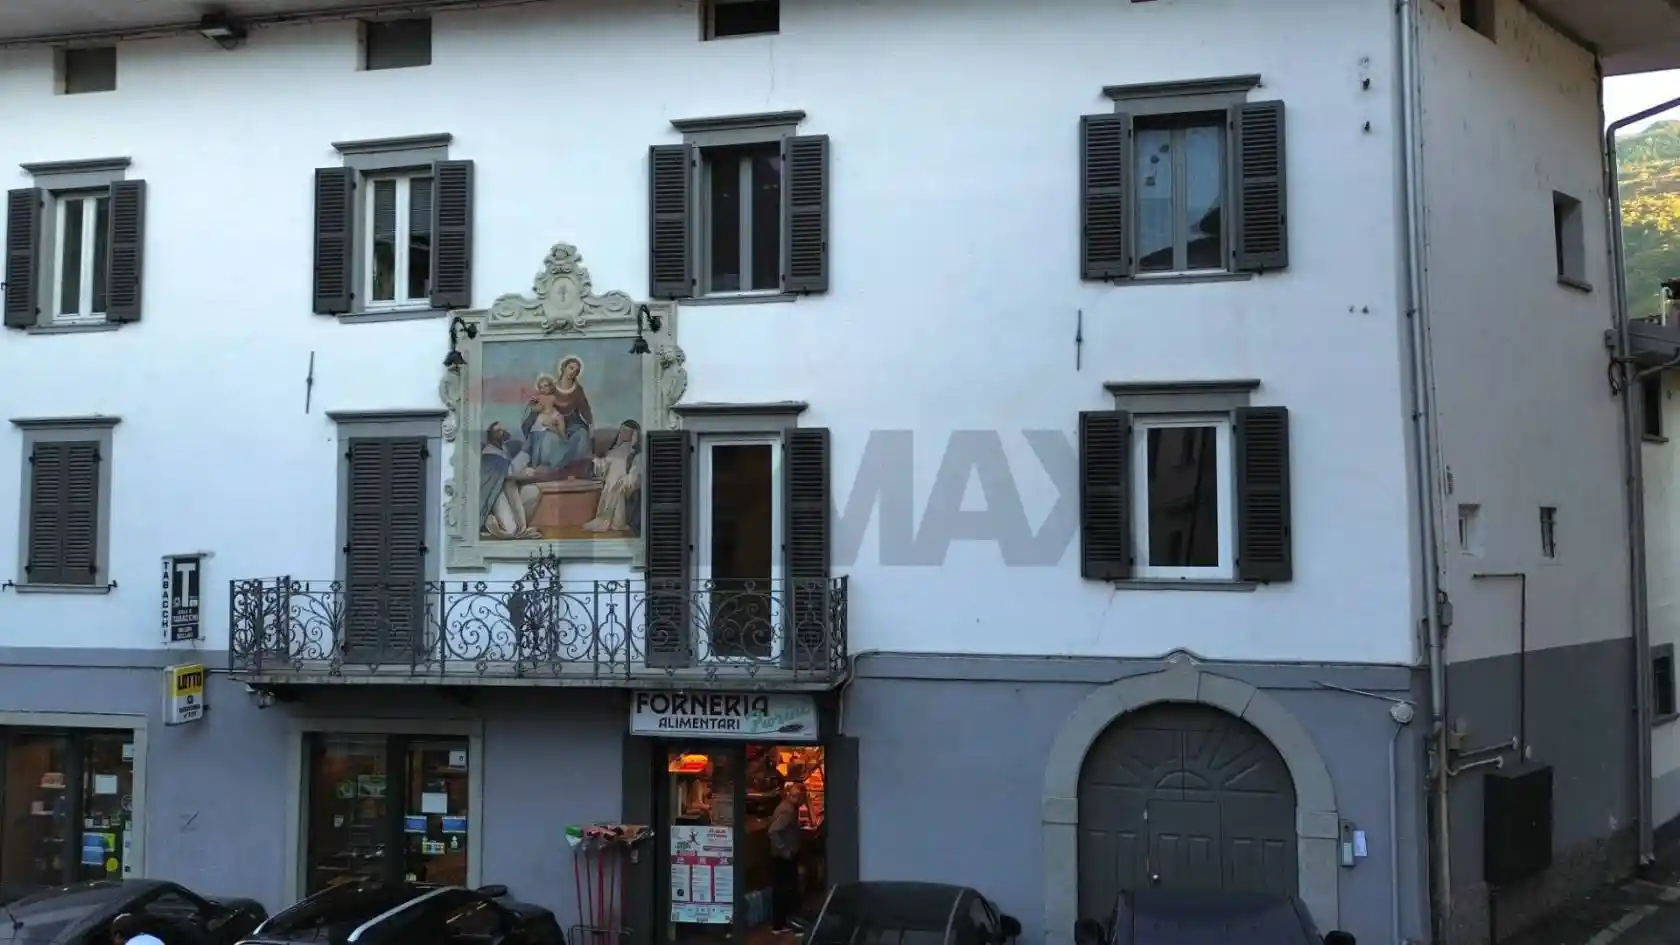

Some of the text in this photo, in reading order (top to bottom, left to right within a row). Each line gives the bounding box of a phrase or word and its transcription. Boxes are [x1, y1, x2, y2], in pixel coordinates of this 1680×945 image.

[176, 563, 196, 607] T
[162, 561, 170, 639] TABACCHI
[178, 671, 202, 690] LOTTO
[636, 693, 769, 717] FORNERIA
[658, 717, 741, 730] ALIMENTARI
